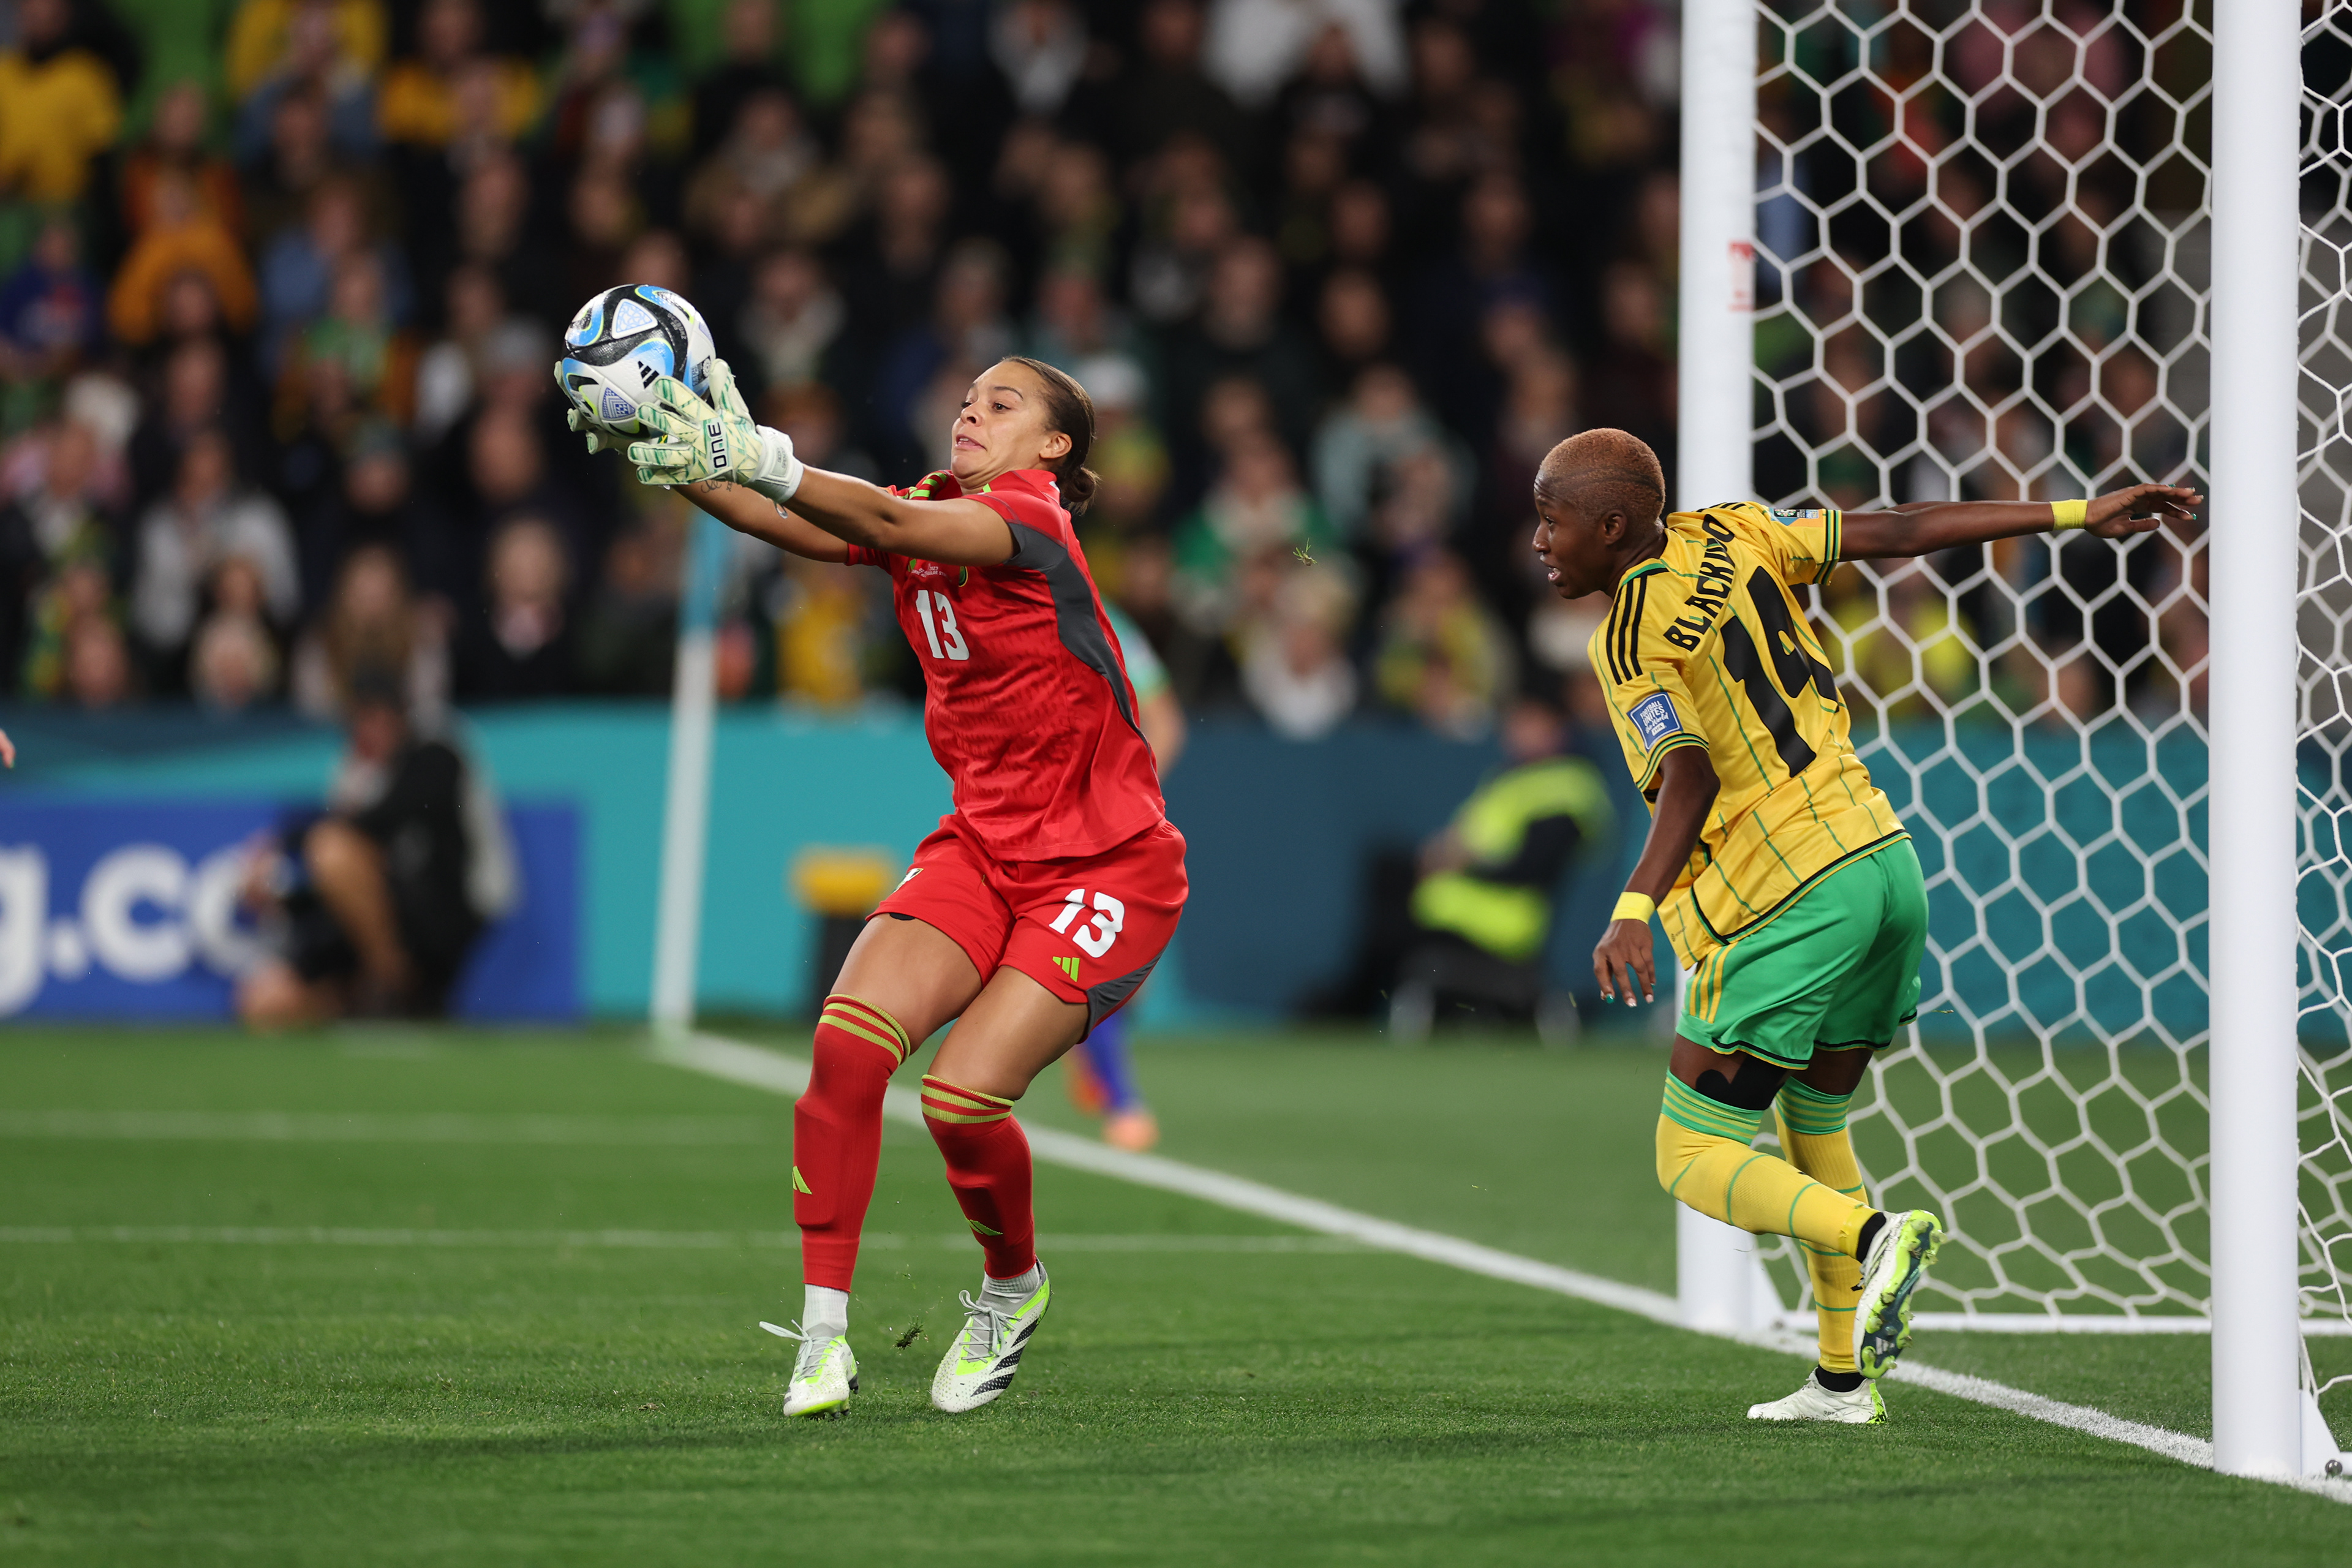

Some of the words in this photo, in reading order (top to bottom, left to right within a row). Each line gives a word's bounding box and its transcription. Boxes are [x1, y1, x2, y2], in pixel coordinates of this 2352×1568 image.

[707, 422, 727, 469] ONE
[915, 589, 970, 662] 13
[1720, 565, 1840, 778] 14
[1640, 700, 1662, 719] FOOTBALL
[1642, 706, 1665, 727] UNITES
[1049, 888, 1126, 959] 13
